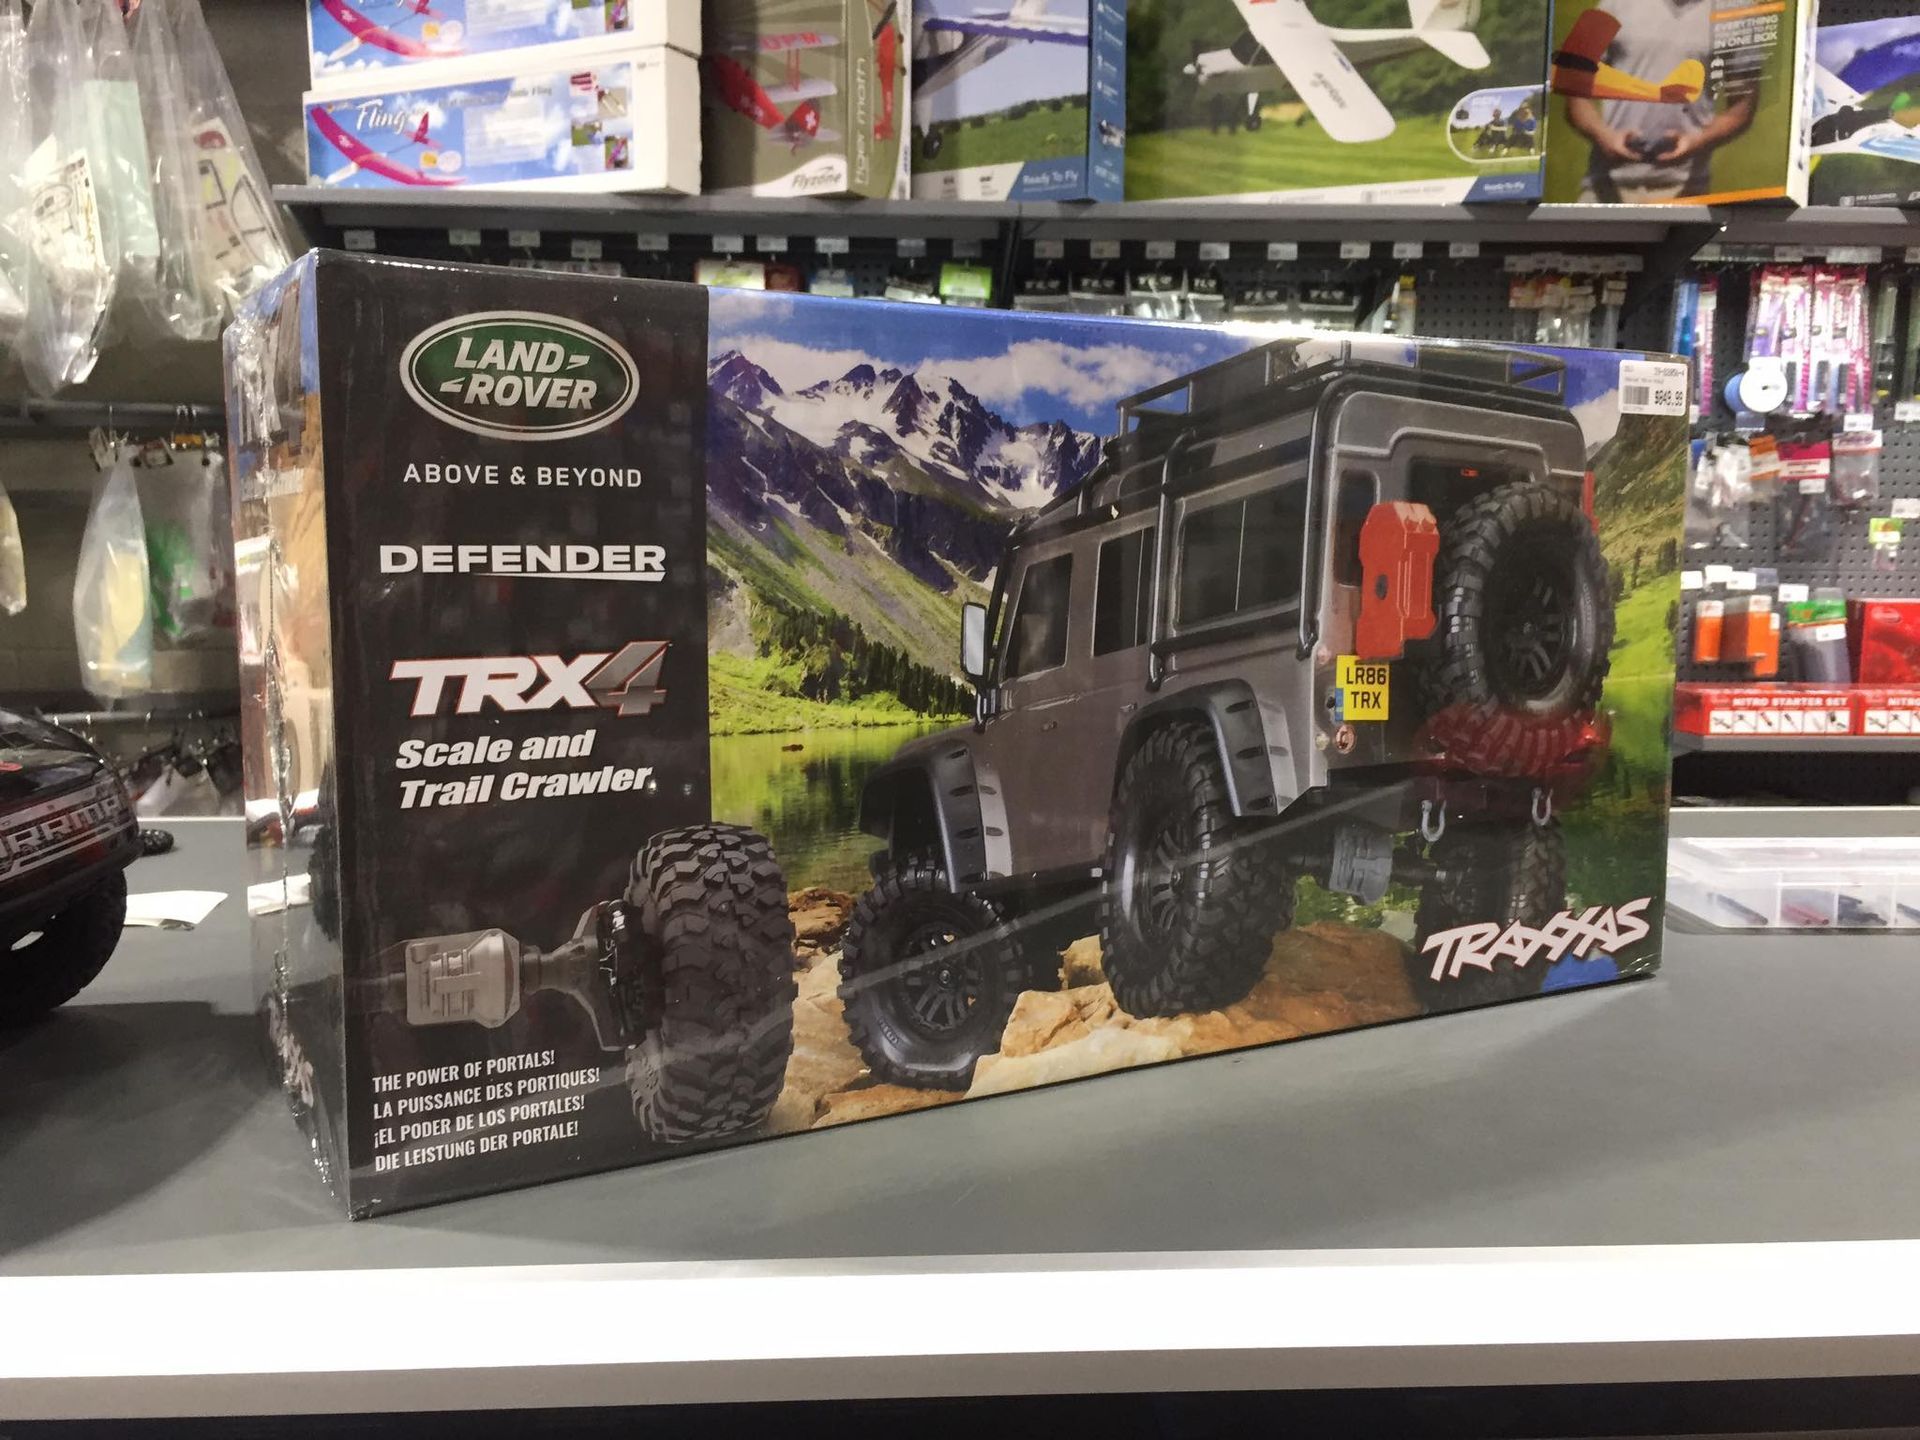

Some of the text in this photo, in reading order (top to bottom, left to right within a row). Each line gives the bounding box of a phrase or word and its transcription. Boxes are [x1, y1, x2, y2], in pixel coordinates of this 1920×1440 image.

[1714, 32, 1777, 49] IN ONE BOX
[356, 98, 405, 135] Fling
[1023, 173, 1050, 186] Ready
[1052, 171, 1063, 182] To
[1065, 169, 1080, 182] Fly
[454, 337, 565, 373] LAND
[464, 373, 597, 409] ROVER
[403, 463, 642, 487] ABOVE & BEYOND
[380, 545, 667, 574] DEFENDER
[1346, 667, 1387, 685] LR86
[1351, 691, 1381, 709] TRX
[1733, 697, 1848, 707] NITRO STARTER SET
[395, 729, 596, 769] Scale and
[400, 766, 653, 808] Trail Crawler
[1421, 897, 1651, 982] TRAXXAS
[372, 1050, 555, 1093] THE POWER OF PORTALS!
[373, 1067, 600, 1120] LA PUISSANCE DES PORTIQUES!
[374, 1095, 585, 1148] ¡EL PODER DE LOS PORTALES!
[375, 1121, 579, 1172] DIE LEISTUNG DER PORTALE!
